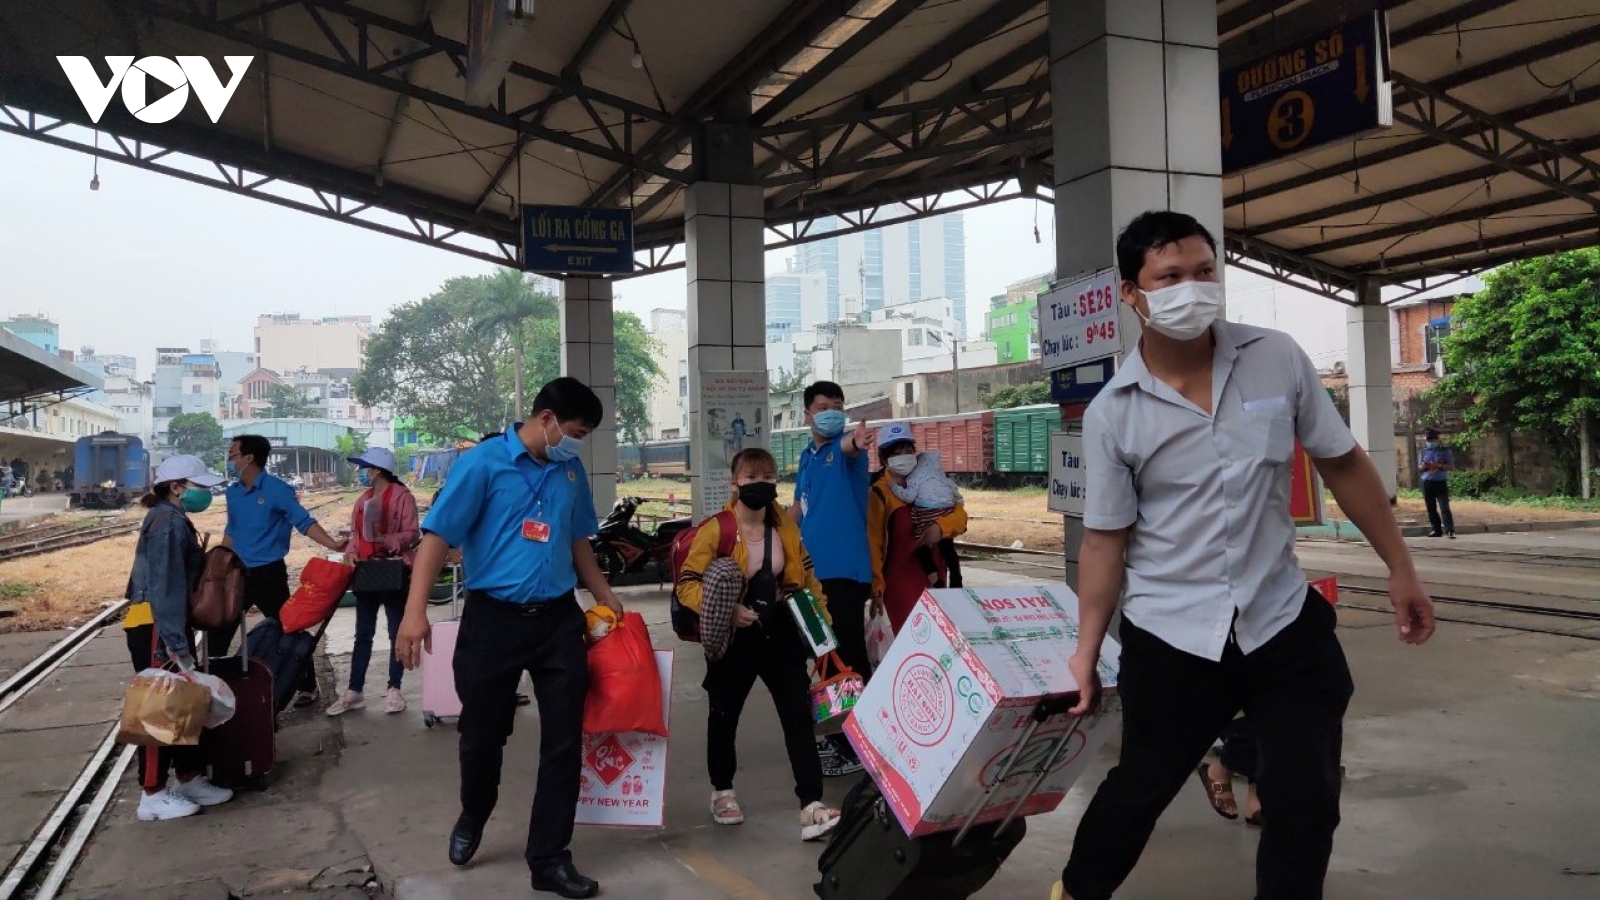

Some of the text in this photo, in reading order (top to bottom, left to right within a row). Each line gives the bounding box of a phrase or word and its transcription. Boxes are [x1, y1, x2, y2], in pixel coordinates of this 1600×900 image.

[1278, 98, 1304, 142] 3
[531, 210, 626, 241] LỐI RA CỔNG GA
[567, 256, 593, 267] EXIT
[1050, 302, 1070, 321] Tàu
[1079, 285, 1112, 318] SE26
[1062, 334, 1074, 351] lúc
[1062, 450, 1080, 469] Tàu
[597, 798, 620, 807] NEW
[622, 799, 649, 807] YEAR
